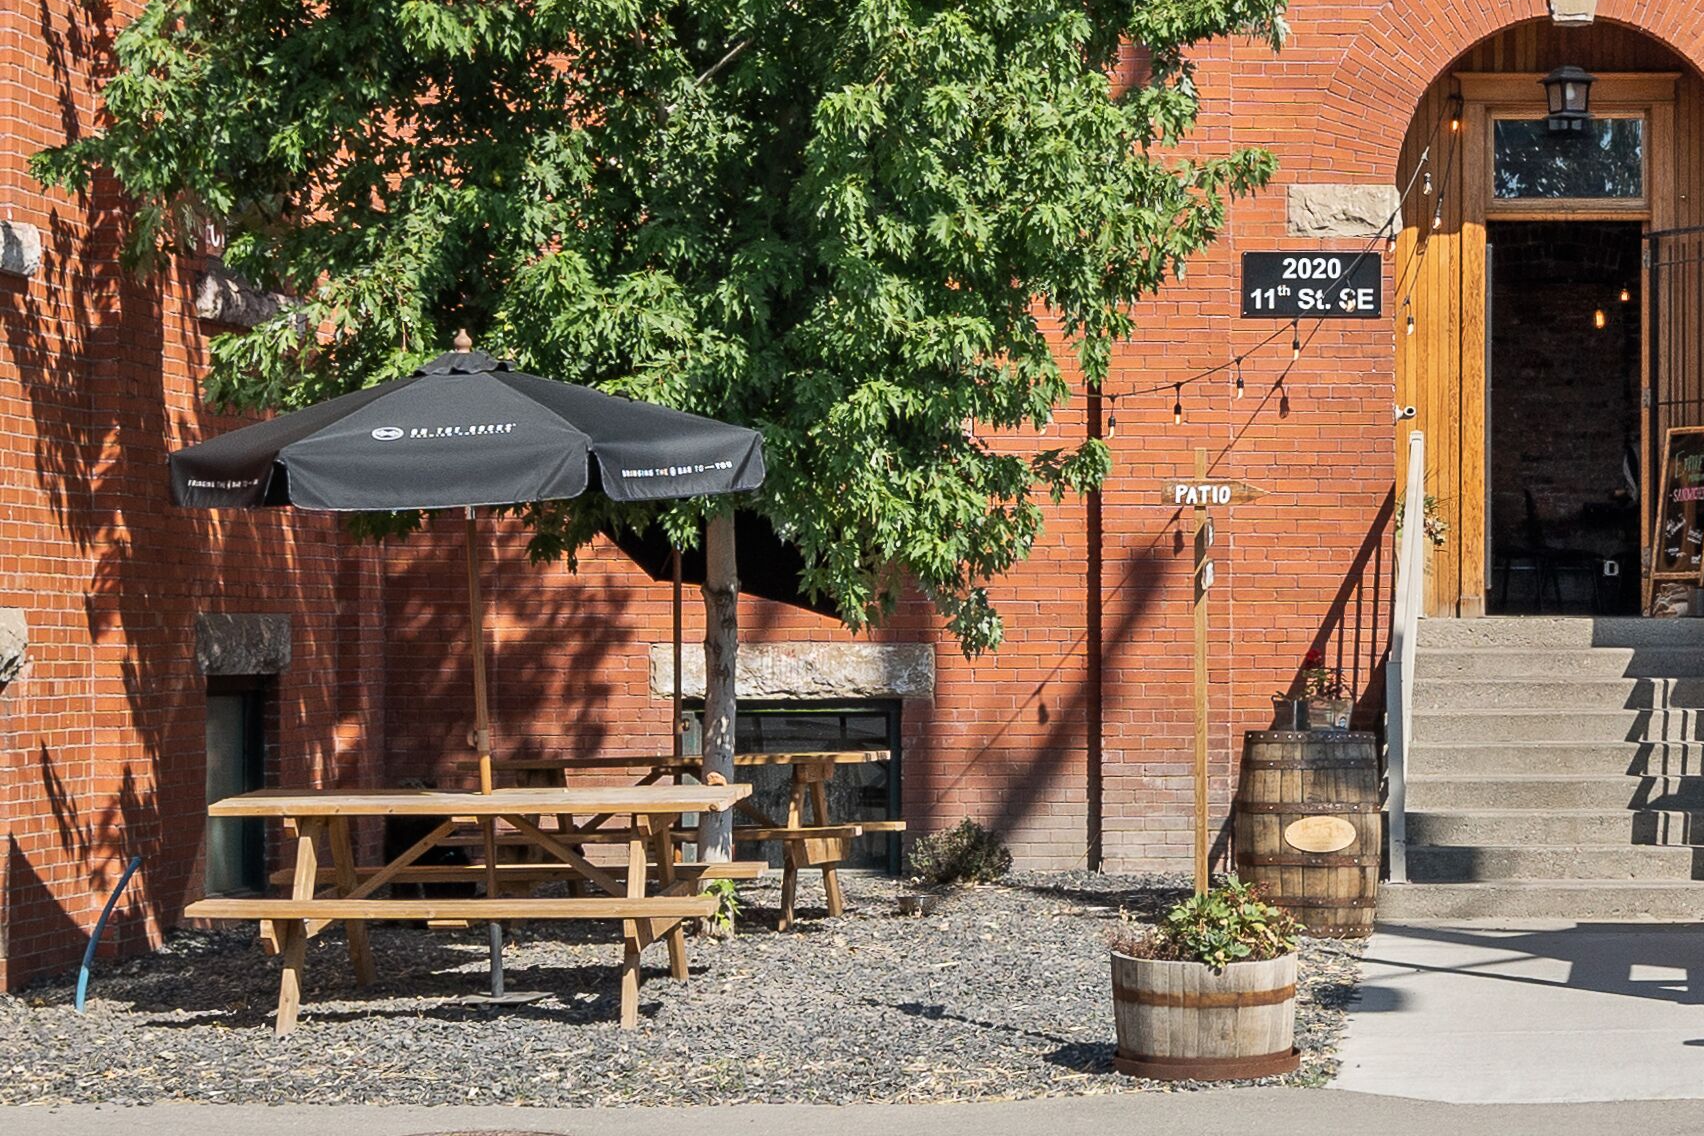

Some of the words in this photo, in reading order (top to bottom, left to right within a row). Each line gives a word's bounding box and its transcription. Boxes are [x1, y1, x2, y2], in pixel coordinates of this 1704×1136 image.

[1282, 258, 1341, 279] 2020
[1250, 285, 1291, 309] 11th
[1298, 289, 1331, 310] St.
[1339, 288, 1374, 312] SE
[1175, 484, 1231, 504] PATIO
